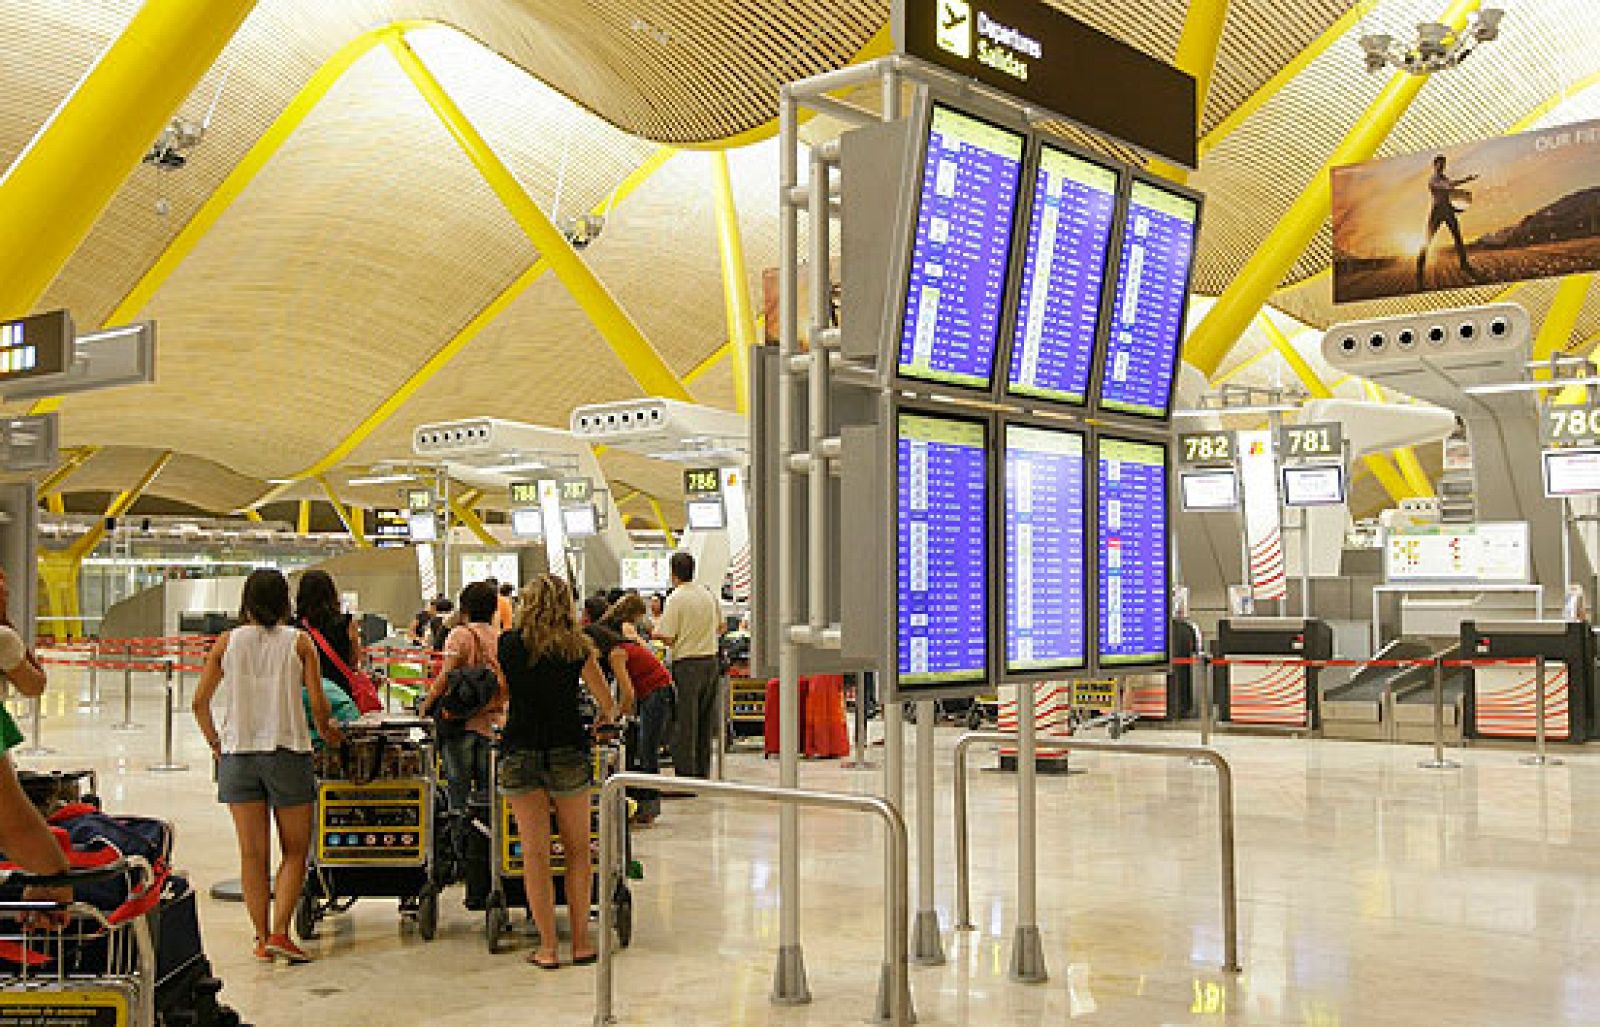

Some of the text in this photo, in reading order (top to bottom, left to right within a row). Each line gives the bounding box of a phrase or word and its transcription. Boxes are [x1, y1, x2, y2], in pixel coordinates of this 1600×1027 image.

[977, 39, 1028, 81] Salidas
[1184, 435, 1228, 461] 782
[1288, 428, 1331, 454] 781
